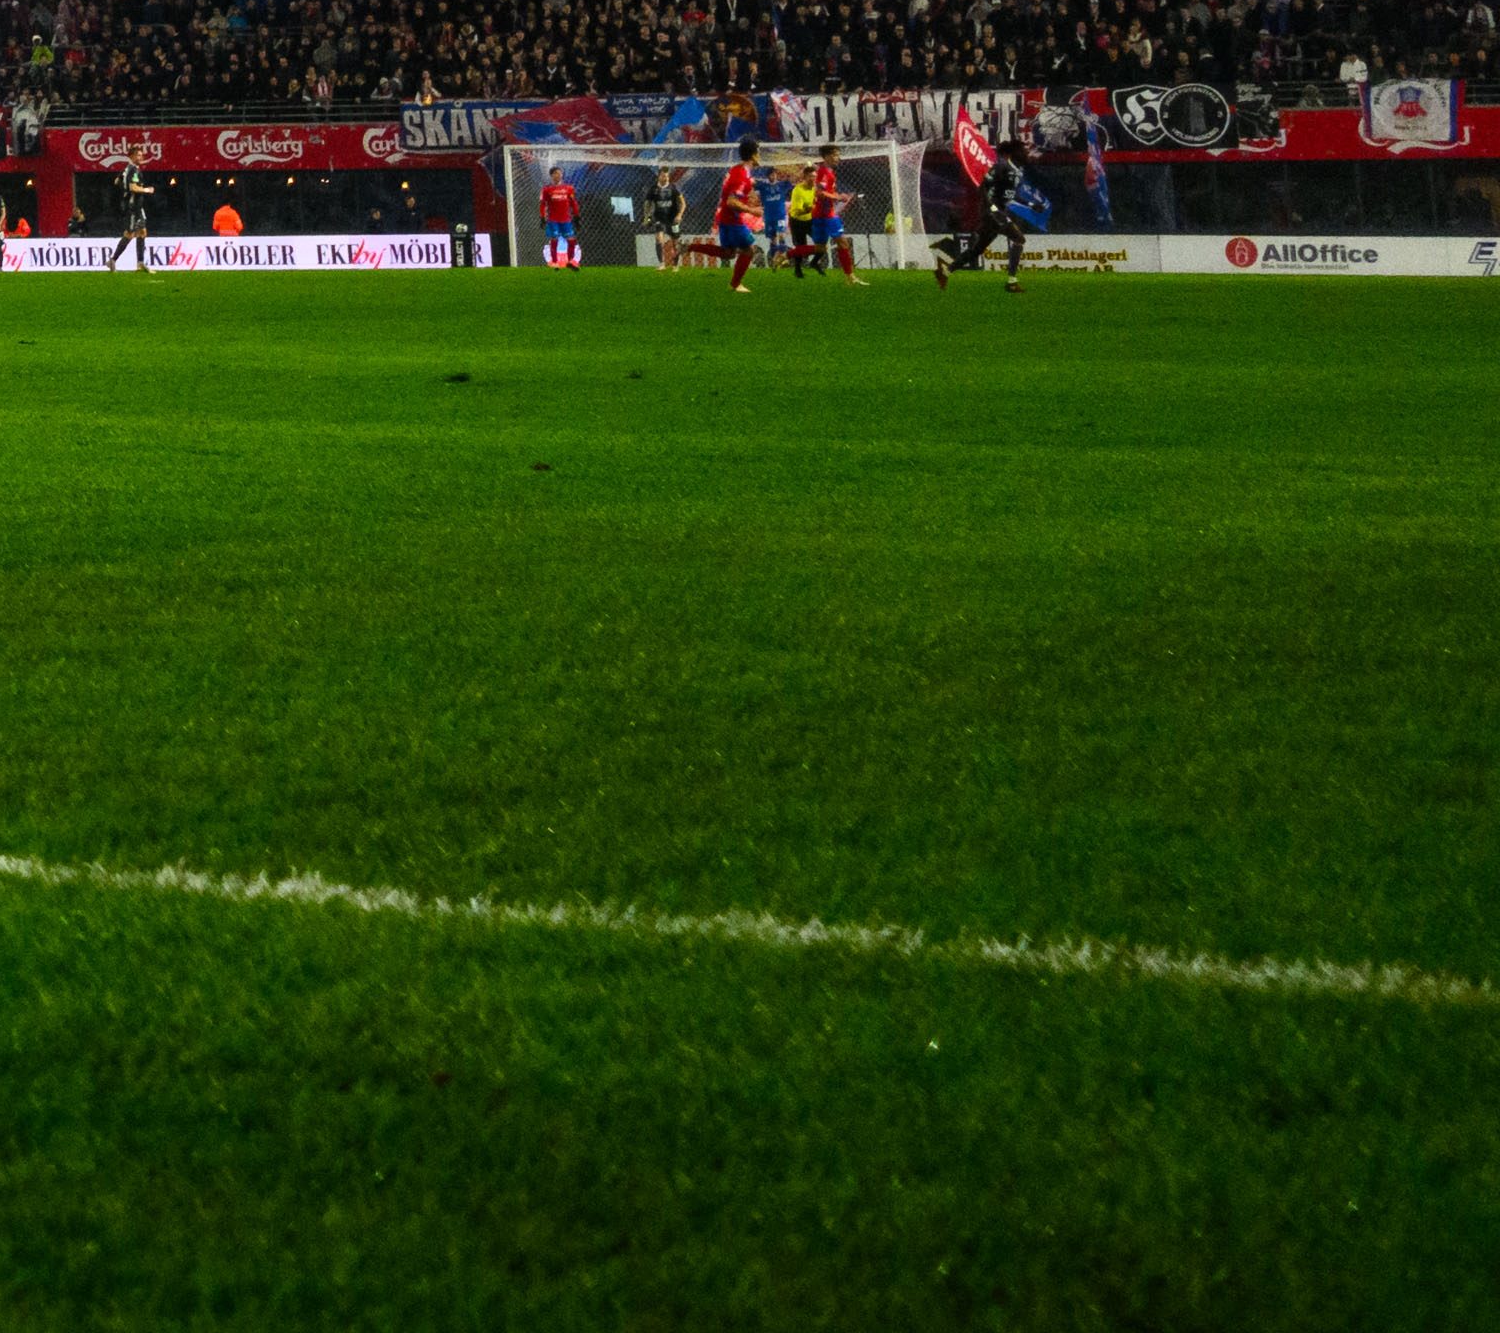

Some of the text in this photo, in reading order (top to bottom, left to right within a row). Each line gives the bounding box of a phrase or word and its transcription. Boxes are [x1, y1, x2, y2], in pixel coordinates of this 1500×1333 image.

[217, 130, 303, 161] Carlsberg
[205, 241, 296, 266] MÖBLER
[316, 243, 355, 265] EKE
[389, 239, 484, 265] MÖBLR
[1046, 248, 1128, 264] Plåtslageri
[1262, 243, 1379, 264] AllOffice
